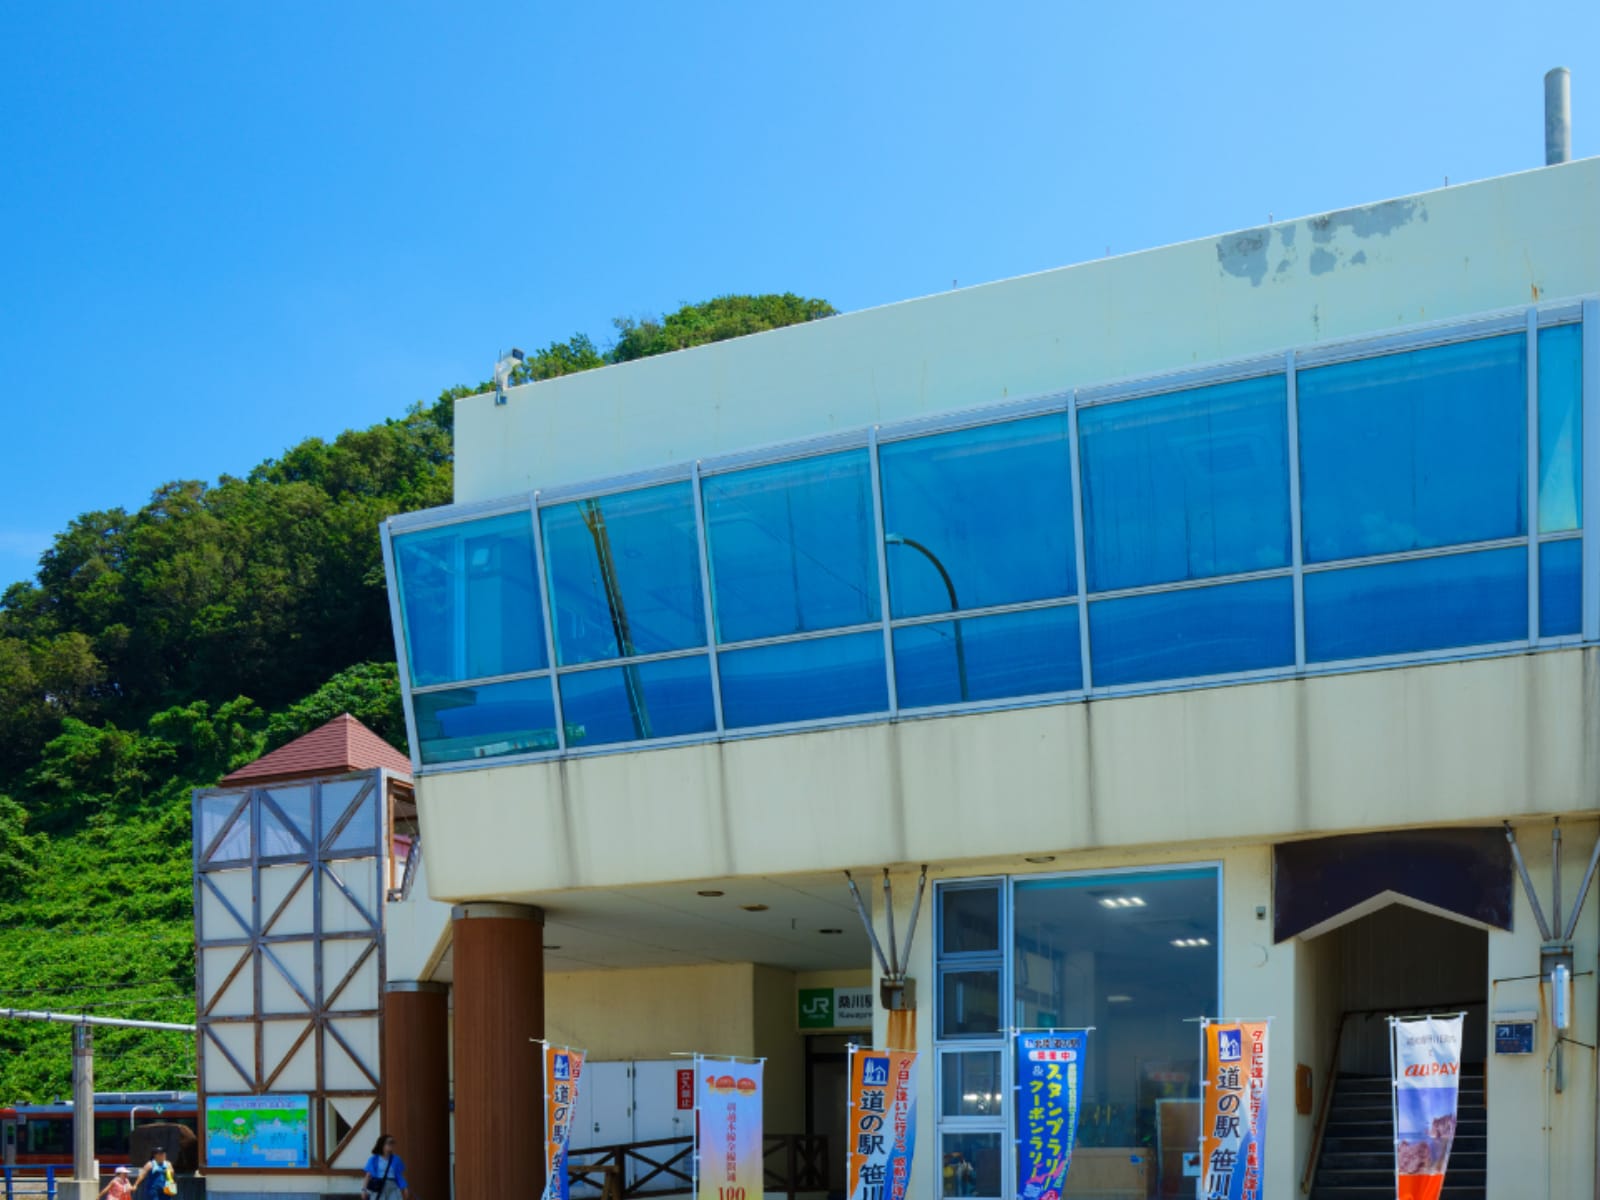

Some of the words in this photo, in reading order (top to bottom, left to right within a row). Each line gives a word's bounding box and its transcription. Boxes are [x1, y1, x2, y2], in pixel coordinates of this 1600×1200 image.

[802, 997, 829, 1014] JR
[705, 1074, 757, 1096] 100
[1432, 1062, 1459, 1076] PAY
[1216, 1066, 1242, 1138] 道の駅
[858, 1090, 885, 1155] 道の駅
[1207, 1148, 1237, 1200] 笹川
